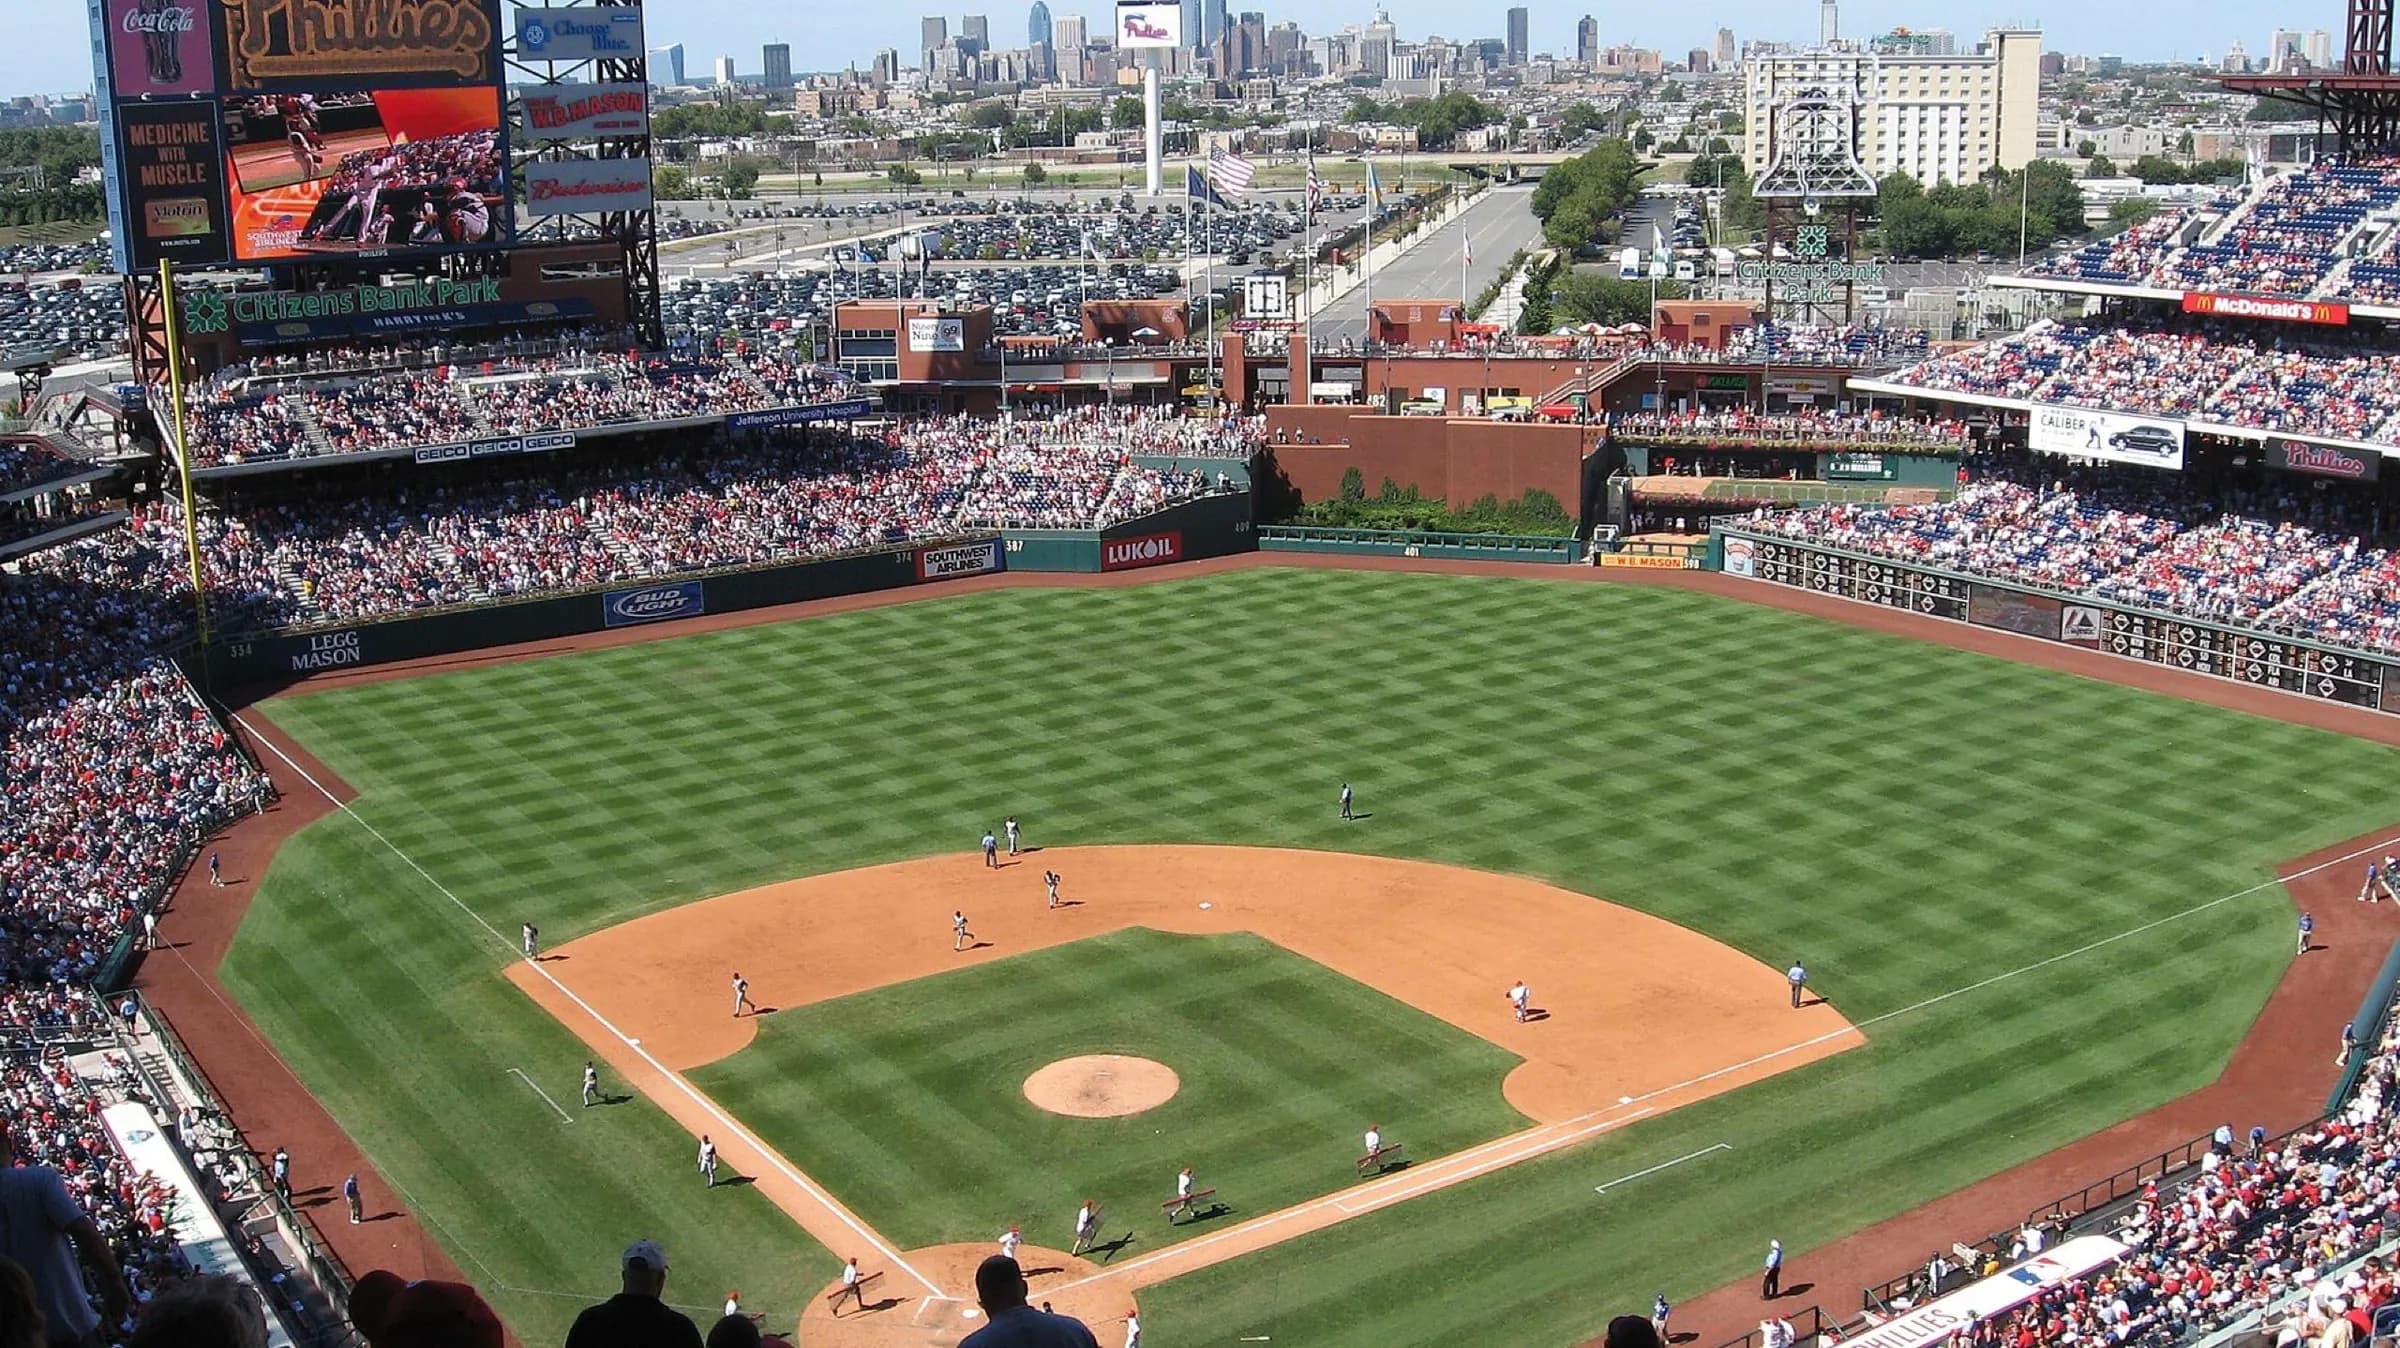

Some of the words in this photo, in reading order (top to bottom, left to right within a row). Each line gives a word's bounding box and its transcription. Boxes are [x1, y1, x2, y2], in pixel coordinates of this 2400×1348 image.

[553, 20, 610, 36] Choose
[569, 90, 644, 122] MASON
[141, 163, 207, 186] MUSCLE
[247, 230, 302, 241] SOUTHWEST
[1739, 260, 1824, 280] Citizens
[1828, 260, 1882, 280] Bank
[233, 291, 354, 322] Citizens
[359, 277, 434, 313] Bank
[436, 273, 501, 305] Park
[1786, 282, 1833, 302] Park
[2213, 297, 2312, 320] McDonald's
[373, 314, 421, 328] HARRY
[912, 322, 940, 332] Ninety
[944, 325, 958, 337] 99
[912, 331, 939, 341] Nine
[736, 413, 781, 427] Jefferson
[782, 407, 825, 421] University
[827, 404, 862, 418] Hospital
[2040, 413, 2085, 430] CALIBER
[417, 446, 467, 460] GEICO
[472, 439, 521, 454] GEICO
[526, 434, 574, 449] GEICO
[2282, 439, 2366, 475] Phillies
[926, 545, 992, 564] SOUTHWEST
[1005, 539, 1024, 552] 387
[1108, 536, 1174, 564] LUKOIL
[936, 558, 984, 574] AIRLINES
[1640, 558, 1681, 568] MASON
[626, 597, 689, 614] LIGHT
[634, 590, 681, 604] BUD
[311, 631, 359, 651] LEGG
[292, 647, 360, 670] MASON
